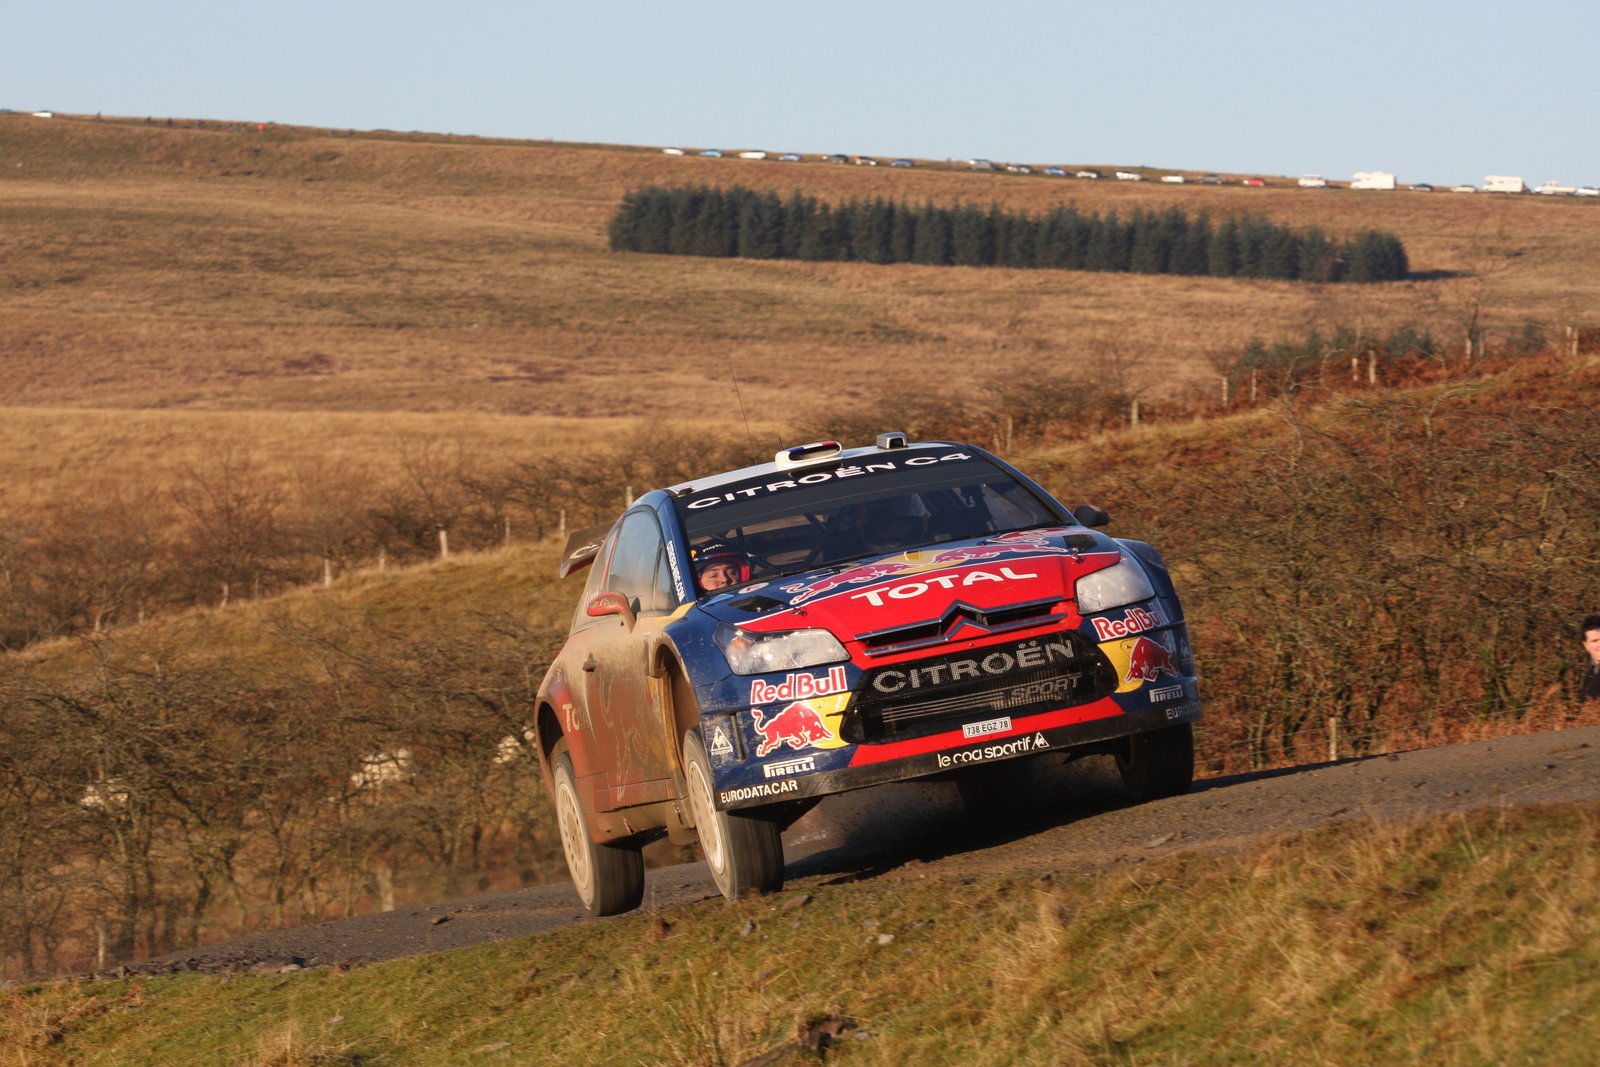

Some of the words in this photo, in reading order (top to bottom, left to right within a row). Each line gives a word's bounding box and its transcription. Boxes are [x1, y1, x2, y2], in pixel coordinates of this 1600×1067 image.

[687, 461, 897, 509] CITROËN
[905, 452, 971, 466] C4
[851, 567, 1038, 606] TOTAL
[873, 640, 1075, 693] CITROËN
[1011, 676, 1080, 699] SPORT
[1149, 685, 1184, 703] PIRELLI
[966, 725, 981, 735] 738
[982, 722, 998, 732] EGZ
[999, 720, 1009, 729] 78
[937, 754, 951, 767] le
[984, 736, 1031, 759] sportif
[763, 756, 816, 778] PIRELLI
[720, 780, 799, 803] EURODATACAR
